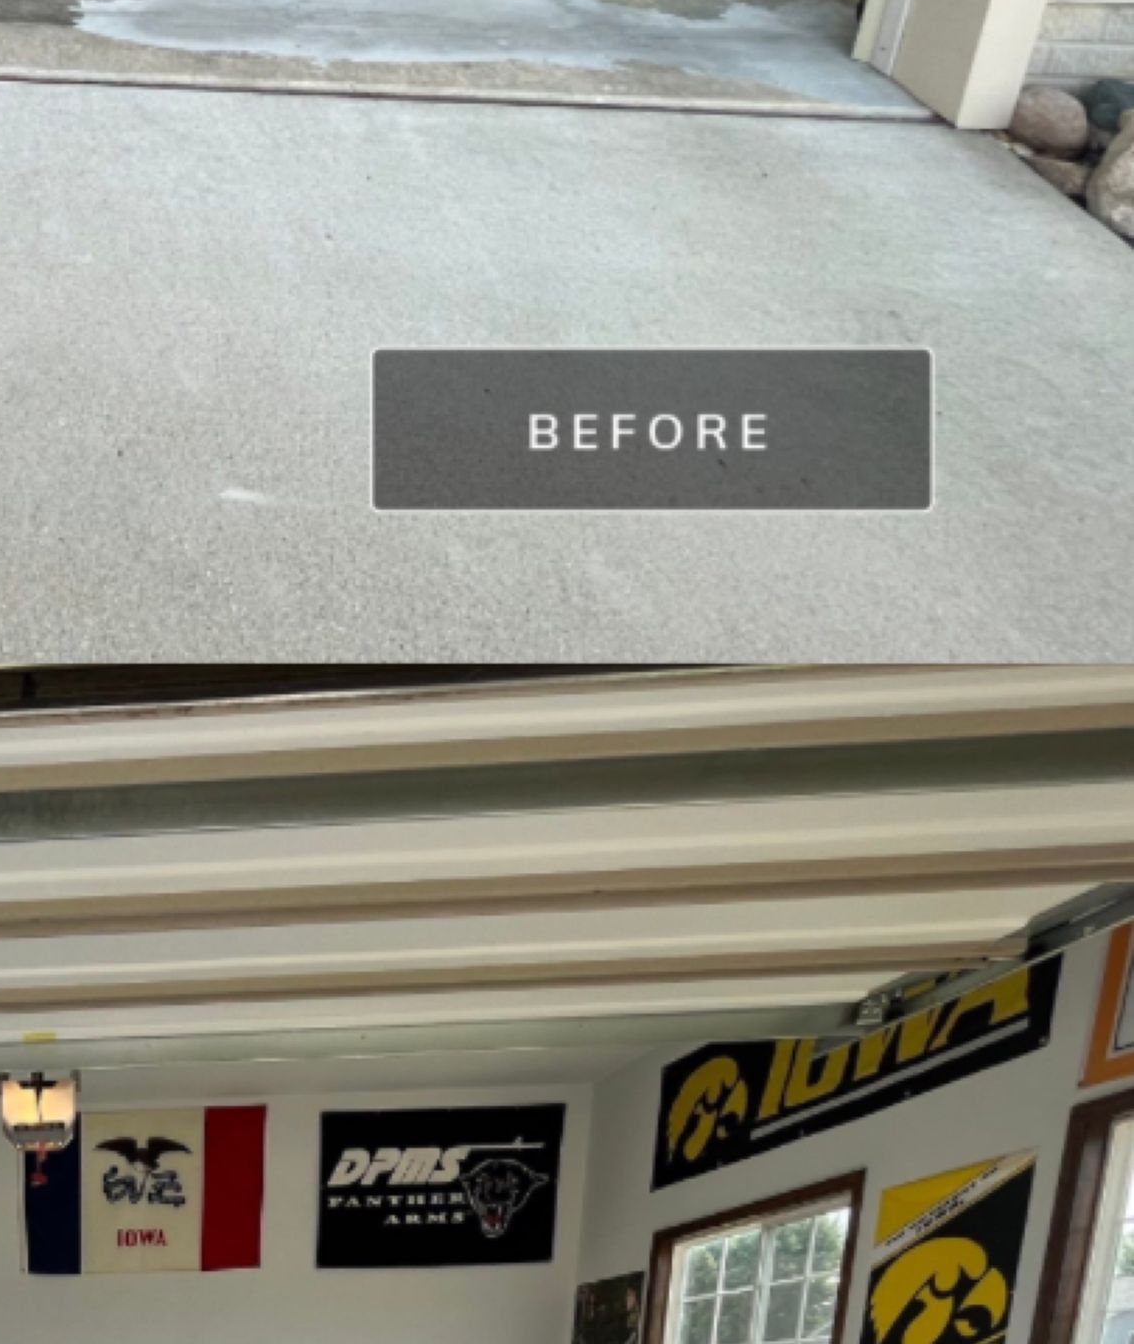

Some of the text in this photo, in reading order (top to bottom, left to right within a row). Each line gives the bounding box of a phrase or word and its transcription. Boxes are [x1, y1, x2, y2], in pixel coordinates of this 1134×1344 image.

[327, 1147, 471, 1187] DPMS
[327, 1192, 465, 1208] PANTHER
[383, 1211, 465, 1225] ARMS
[116, 1229, 168, 1247] IOWA
